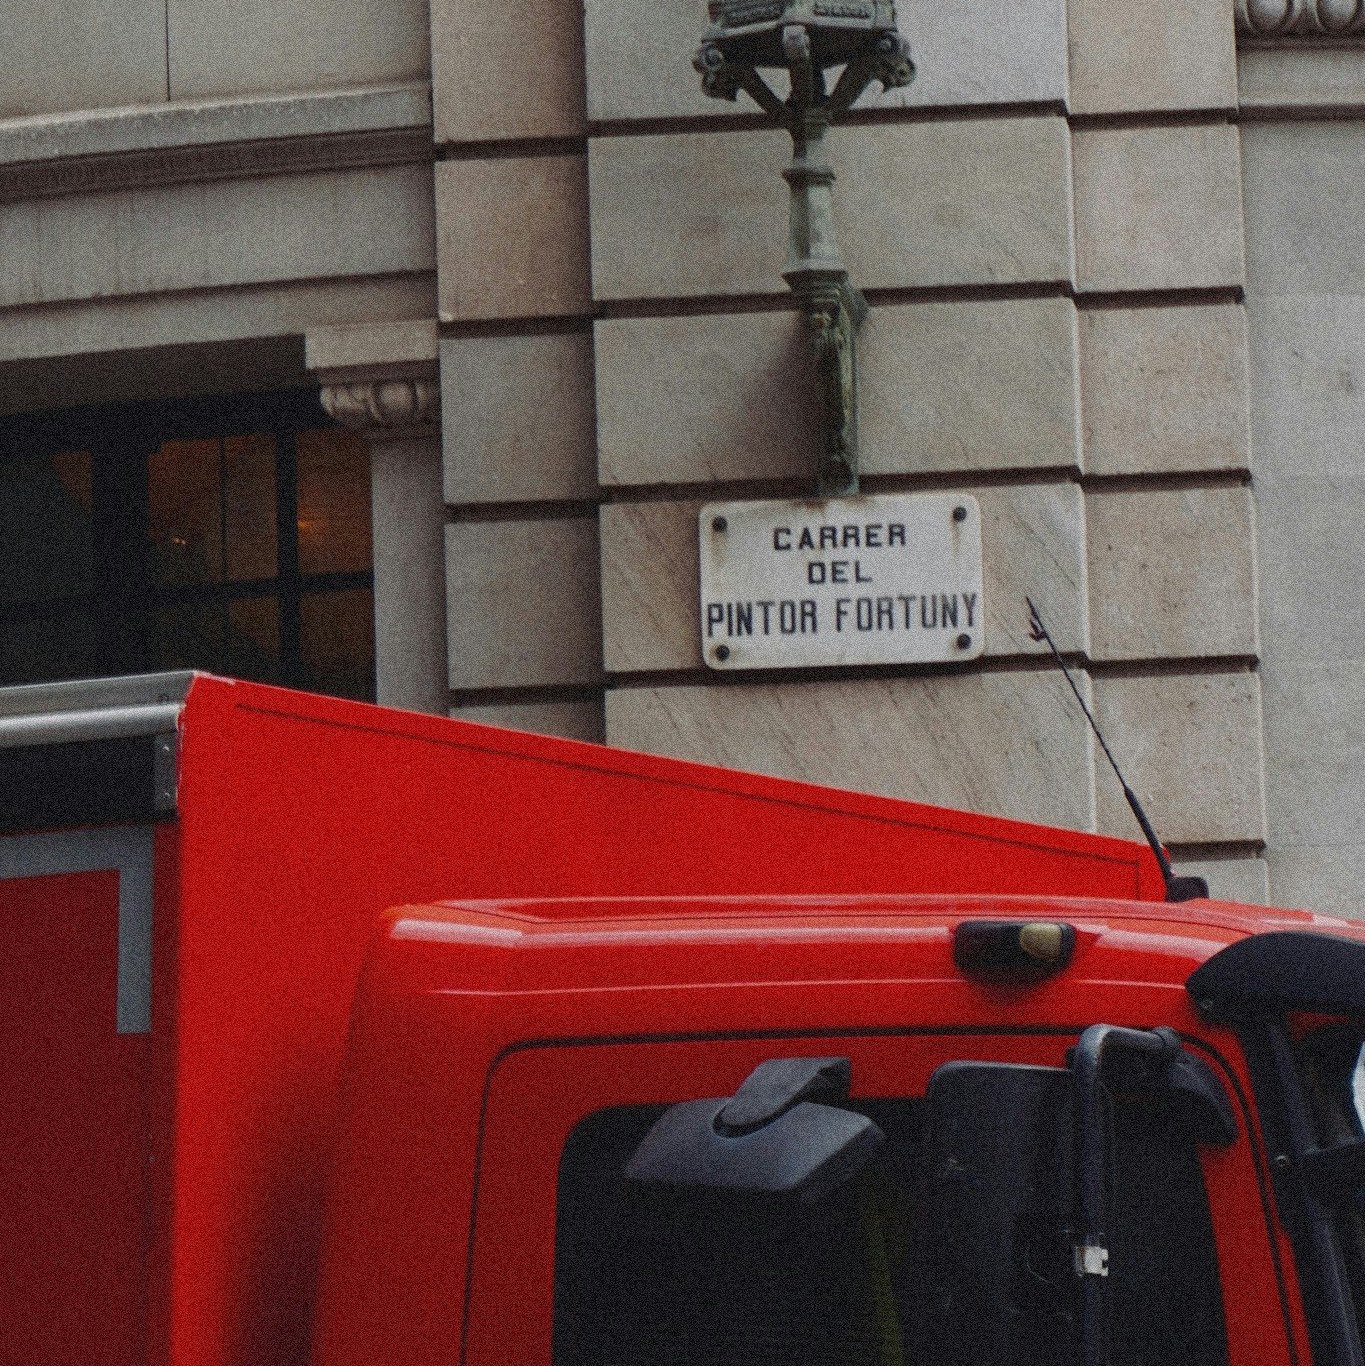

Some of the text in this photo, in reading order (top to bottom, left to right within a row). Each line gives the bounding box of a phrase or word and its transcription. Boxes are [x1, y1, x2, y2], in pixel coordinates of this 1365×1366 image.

[773, 523, 906, 551] CARRER
[807, 560, 872, 585] DEL
[707, 592, 978, 637] PINTOR FORTUNY
